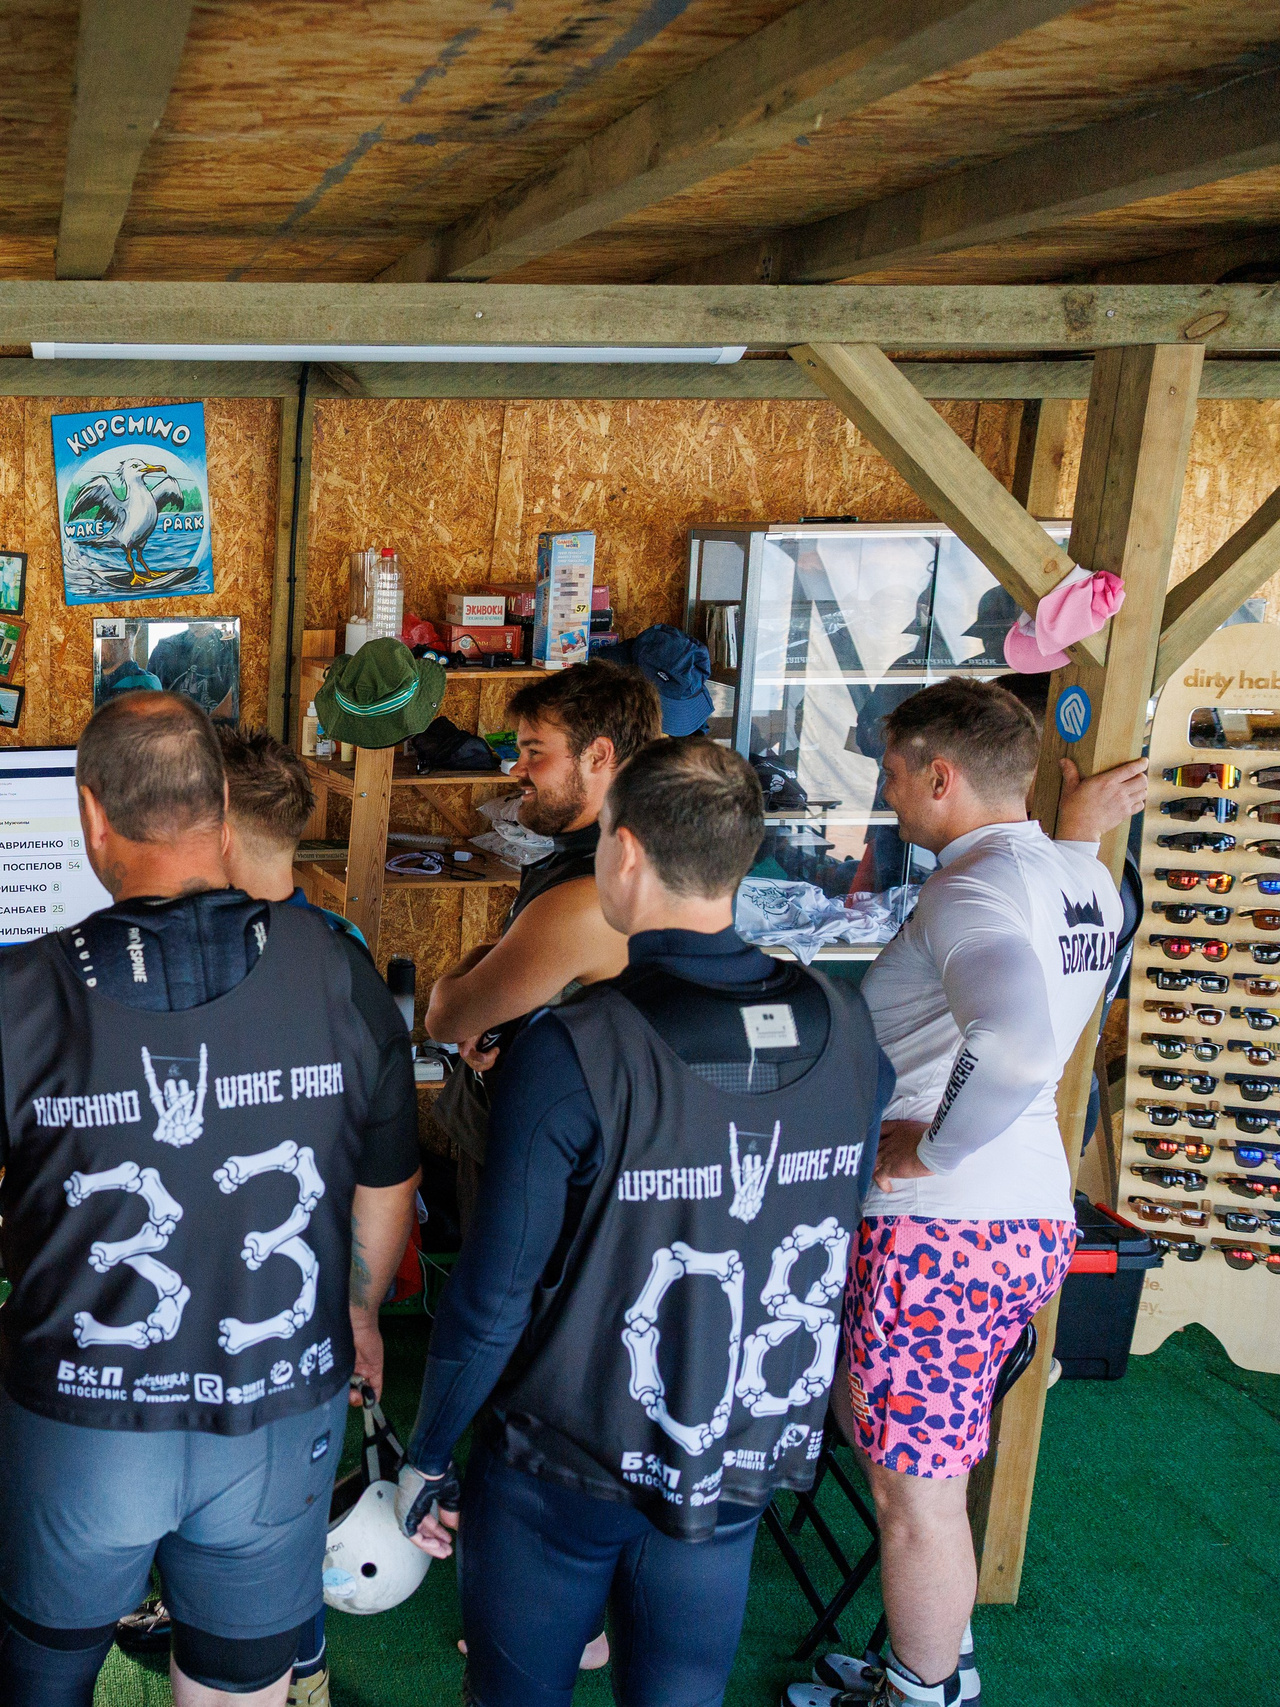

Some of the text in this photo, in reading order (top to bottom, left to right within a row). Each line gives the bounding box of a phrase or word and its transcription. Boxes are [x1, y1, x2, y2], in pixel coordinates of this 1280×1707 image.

[65, 414, 191, 457] KUPCHINO
[64, 515, 205, 539] WAKE PARK
[465, 604, 503, 616] ЭКИВОКИ
[575, 604, 586, 612] 57
[1183, 668, 1235, 699] dirty
[69, 839, 80, 848] 18
[3, 862, 63, 872] ПОСПЕЛОВ
[68, 861, 81, 870] 54
[52, 883, 60, 892] 8
[52, 904, 64, 913] 25
[1058, 931, 1115, 976] GORILLA
[32, 1062, 345, 1129] KUPCHINO WAKE PARK
[927, 1047, 980, 1143] #GORILLAENERGY
[777, 1147, 833, 1186] WAKE
[63, 1139, 326, 1355] 33
[621, 1216, 851, 1456] 08
[57, 1382, 128, 1401] АВТОСЕРВИС
[735, 1459, 766, 1471] HABITS
[736, 1449, 767, 1461] DIRTY
